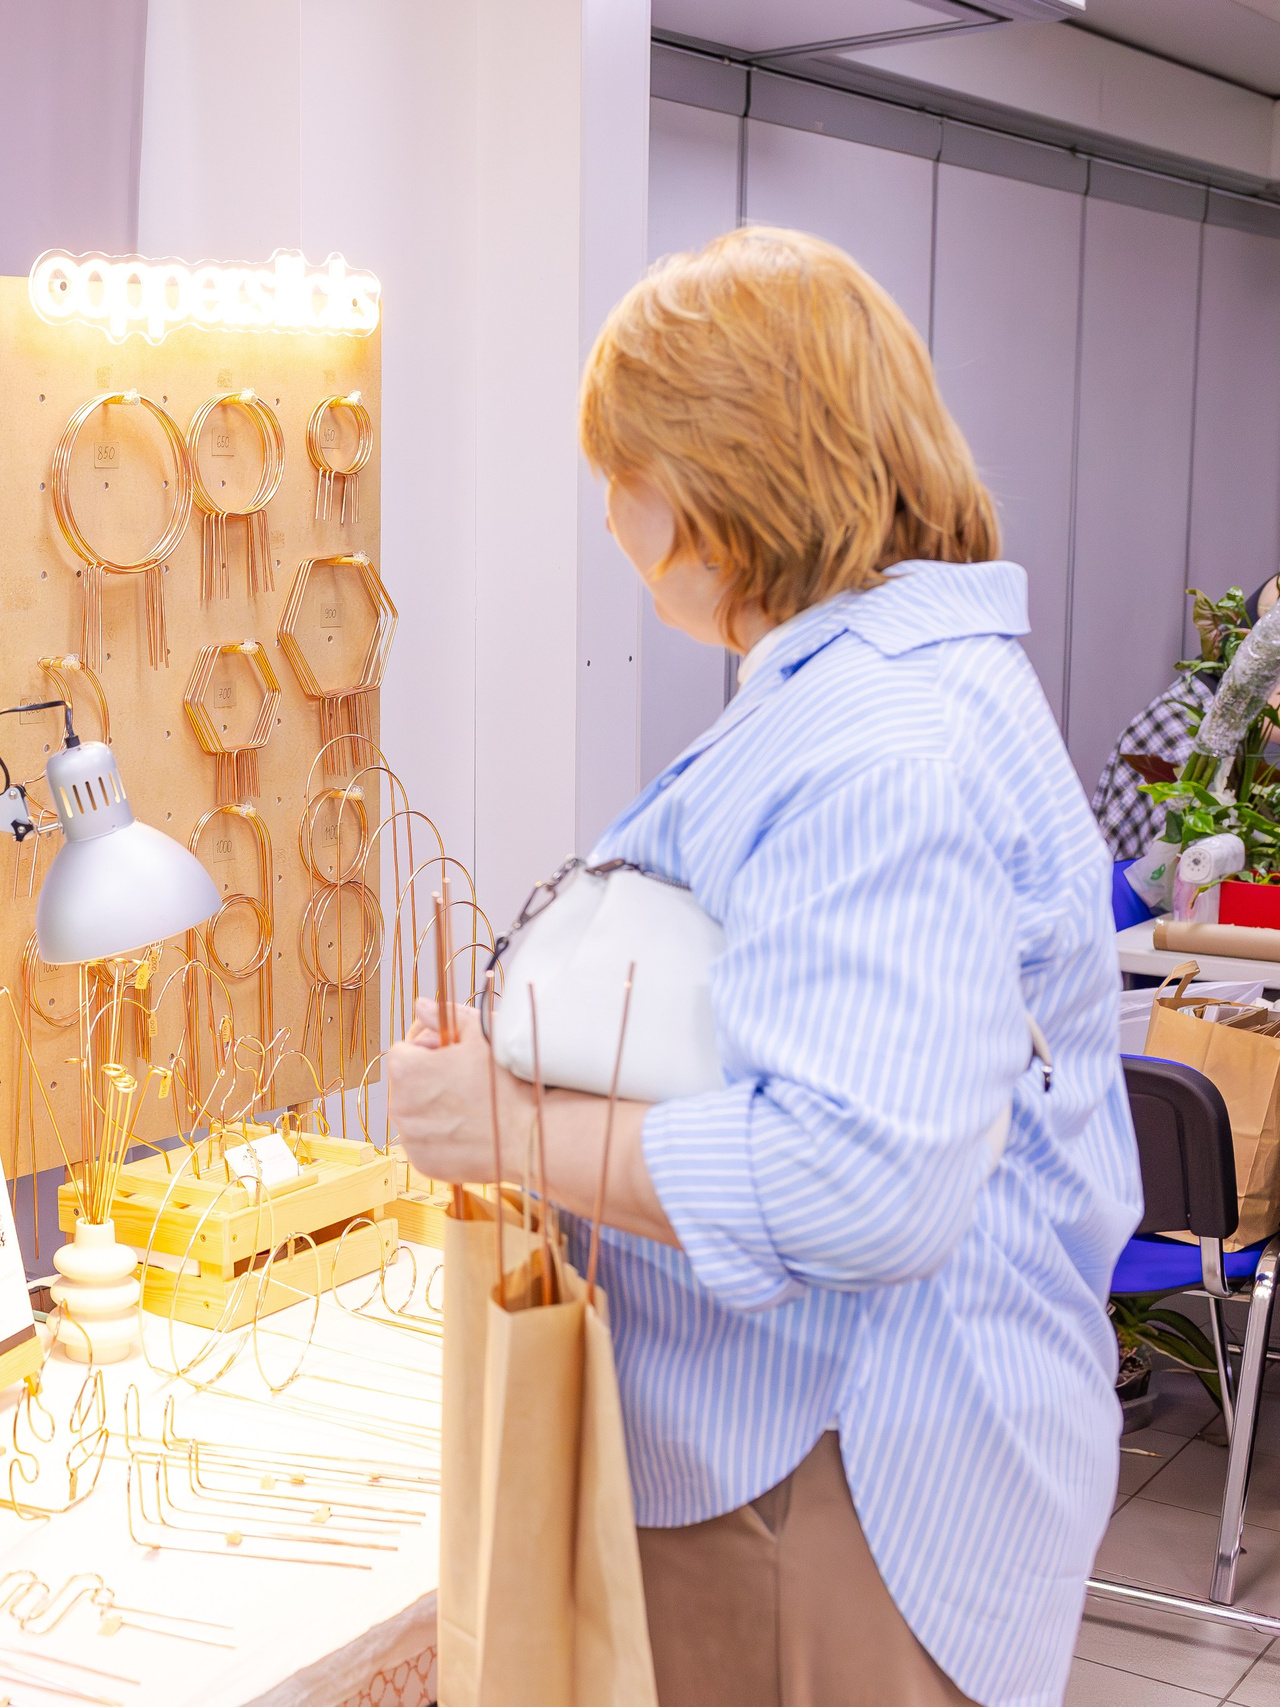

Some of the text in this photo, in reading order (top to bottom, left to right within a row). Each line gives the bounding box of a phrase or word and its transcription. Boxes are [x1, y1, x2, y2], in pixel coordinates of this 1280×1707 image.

[216, 434, 230, 449] 650
[97, 445, 116, 461] 850
[324, 608, 337, 619] 900
[215, 839, 233, 854] 1000
